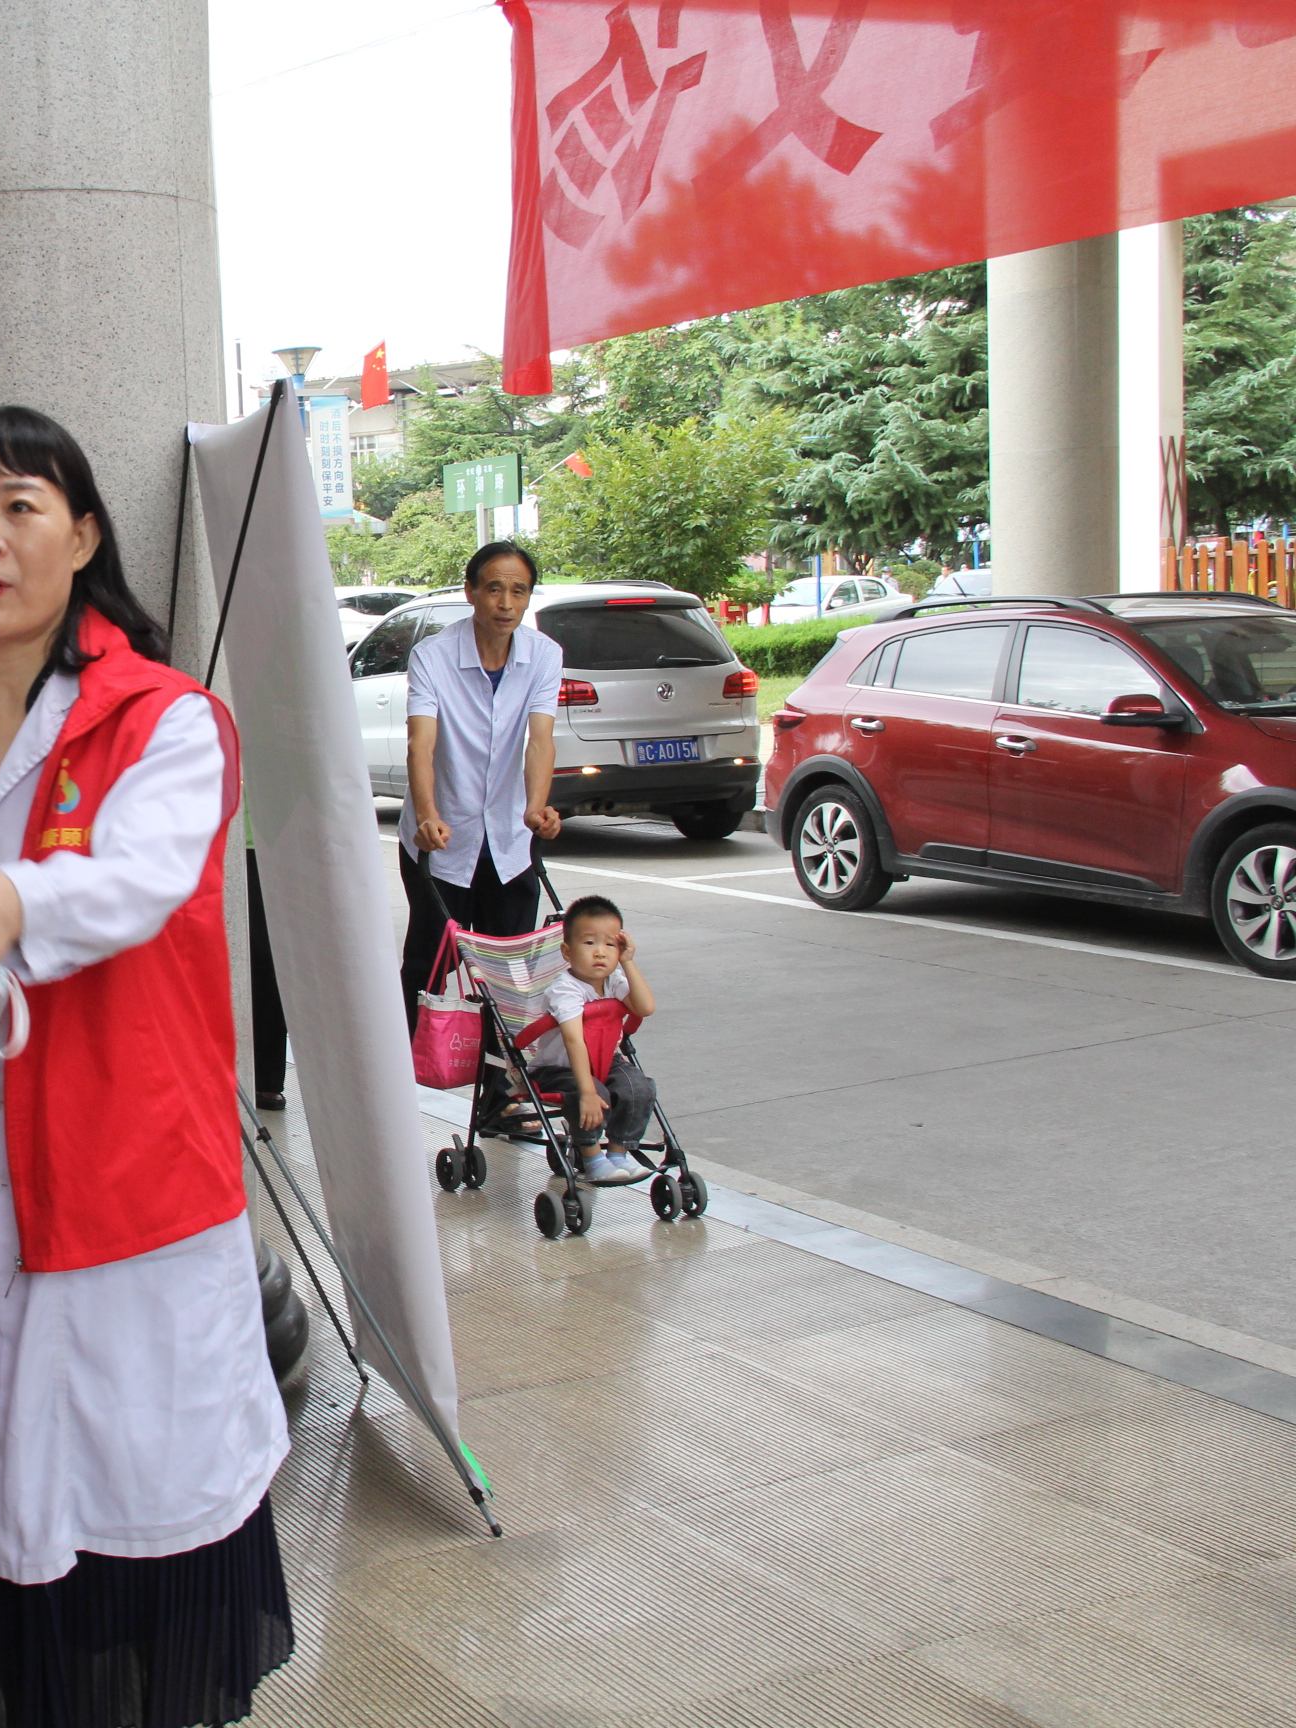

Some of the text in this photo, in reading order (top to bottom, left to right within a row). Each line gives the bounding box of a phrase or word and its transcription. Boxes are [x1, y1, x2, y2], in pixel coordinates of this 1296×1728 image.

[319, 421, 333, 507] 时时刻刻保平安
[331, 408, 345, 494] 酒后不摸方向盘
